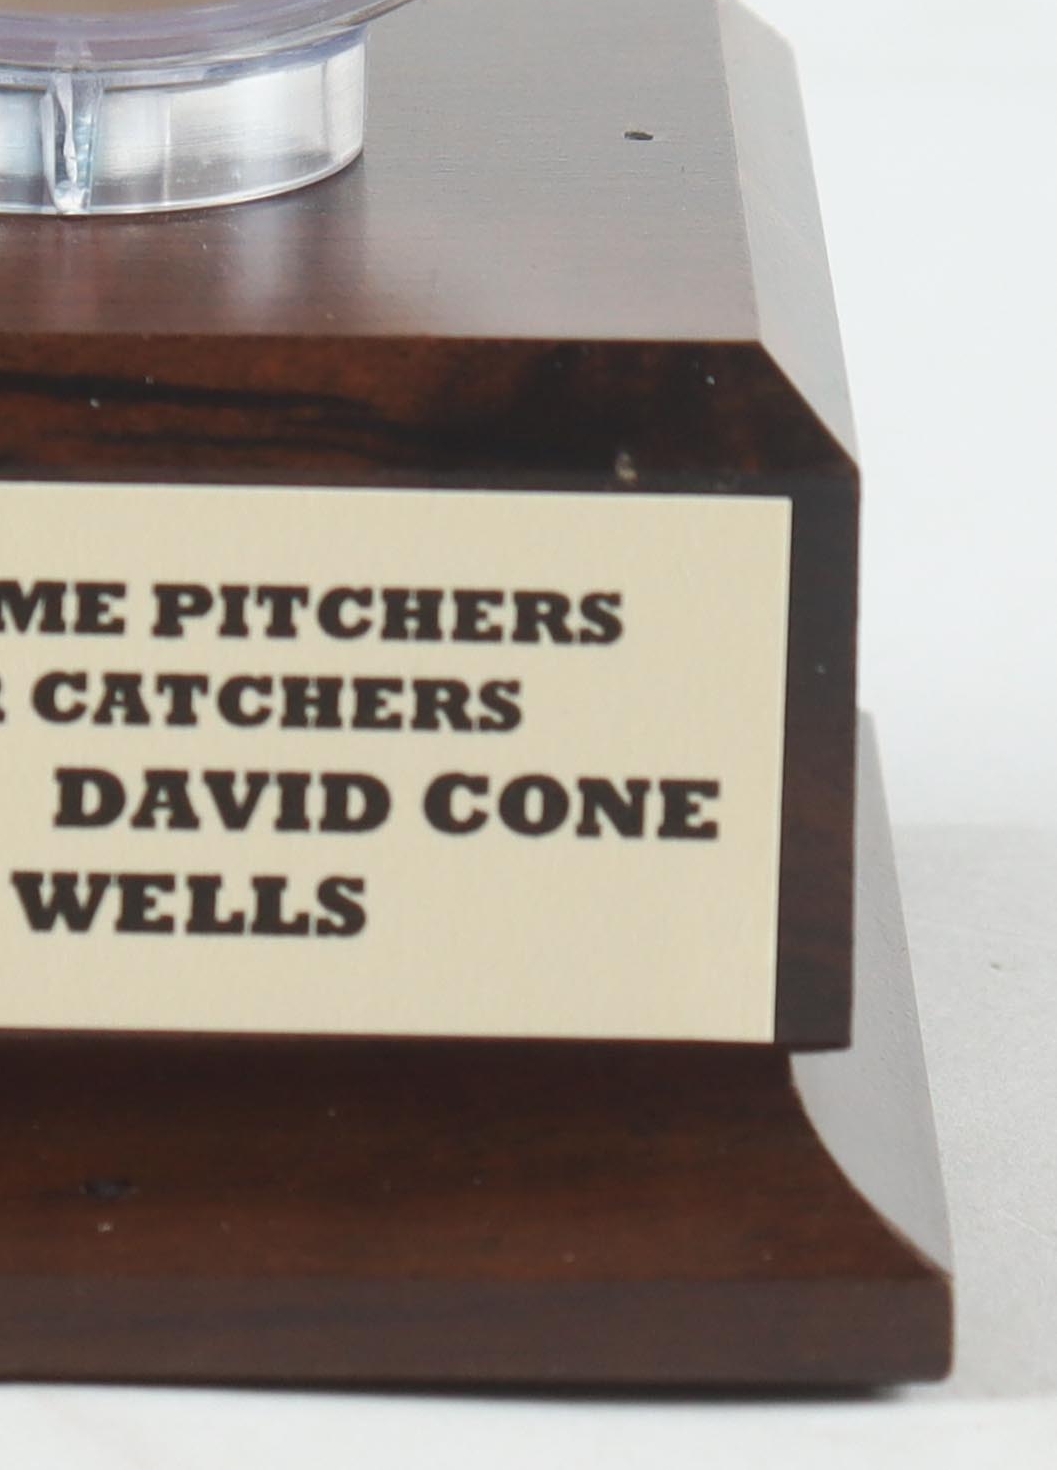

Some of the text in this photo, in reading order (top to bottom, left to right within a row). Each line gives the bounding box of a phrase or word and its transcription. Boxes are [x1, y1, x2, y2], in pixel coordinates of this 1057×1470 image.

[153, 584, 622, 644] PITCHERS
[33, 672, 521, 731] CATCHERS
[55, 768, 719, 839] DAVID CONE
[12, 872, 365, 936] WELLS
